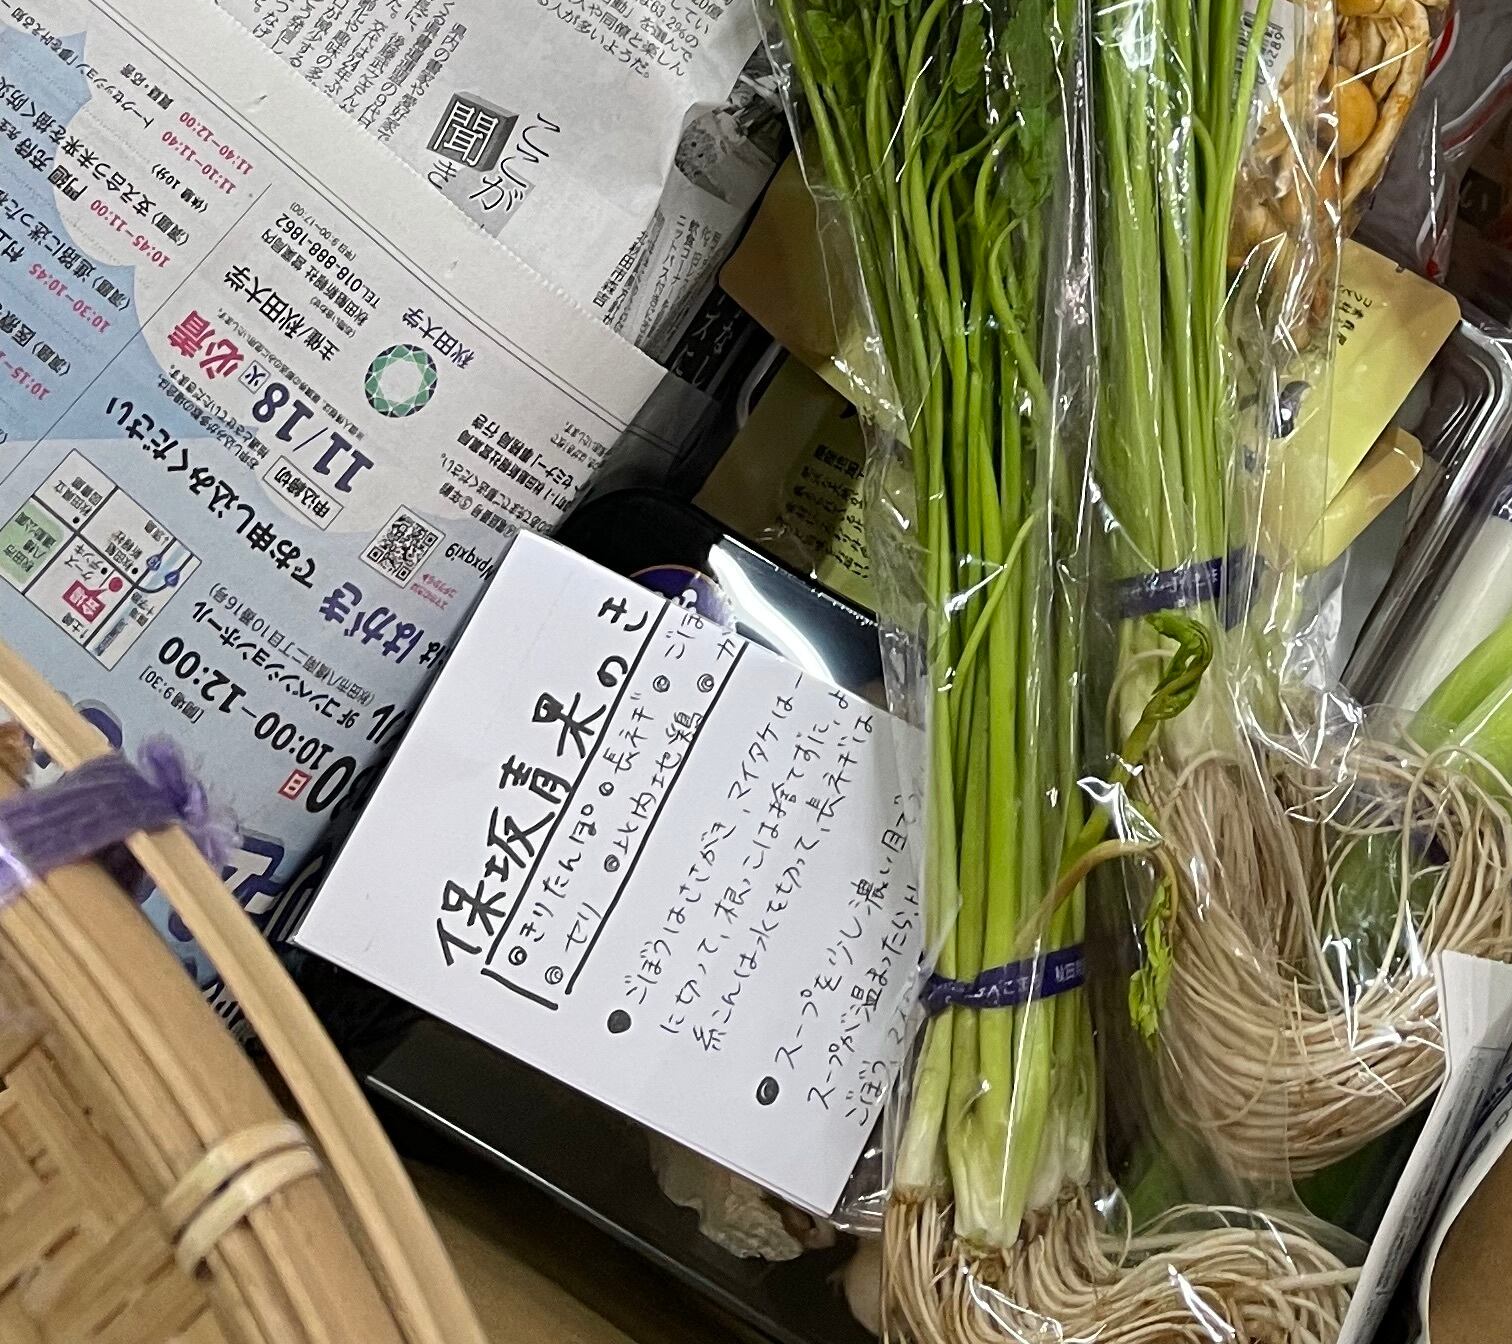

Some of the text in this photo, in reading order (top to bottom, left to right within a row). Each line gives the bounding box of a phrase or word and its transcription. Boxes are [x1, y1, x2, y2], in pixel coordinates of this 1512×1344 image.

[471, 109, 565, 220] ここが
[164, 307, 246, 384] 必着
[398, 303, 476, 370] 秋田大学
[247, 379, 375, 494] 11/18
[99, 392, 423, 665] はがき でお申し込みください
[188, 599, 358, 729] 9F コンベンションホール
